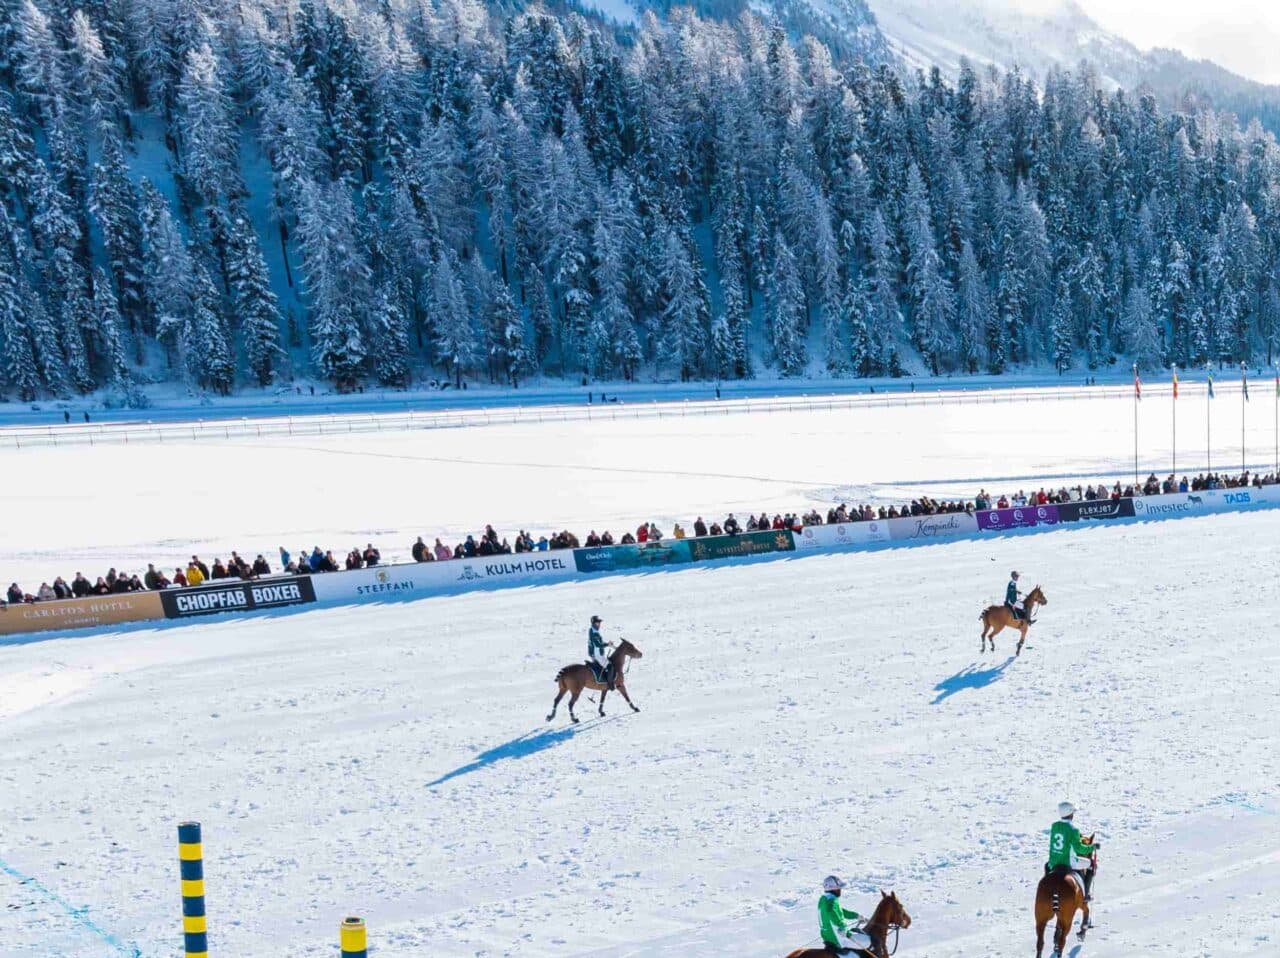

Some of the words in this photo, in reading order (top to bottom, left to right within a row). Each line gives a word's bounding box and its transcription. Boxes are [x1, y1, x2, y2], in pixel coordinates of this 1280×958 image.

[1145, 503, 1189, 515] Investec
[485, 563, 522, 576] KULM
[525, 558, 566, 572] HOTEL
[357, 581, 414, 595] STEFFANI
[176, 590, 247, 612] CHOPFAB
[252, 584, 301, 603] BOXER
[23, 606, 87, 618] CARLTON
[90, 601, 134, 612] HOTEL
[1053, 833, 1064, 850] 3
